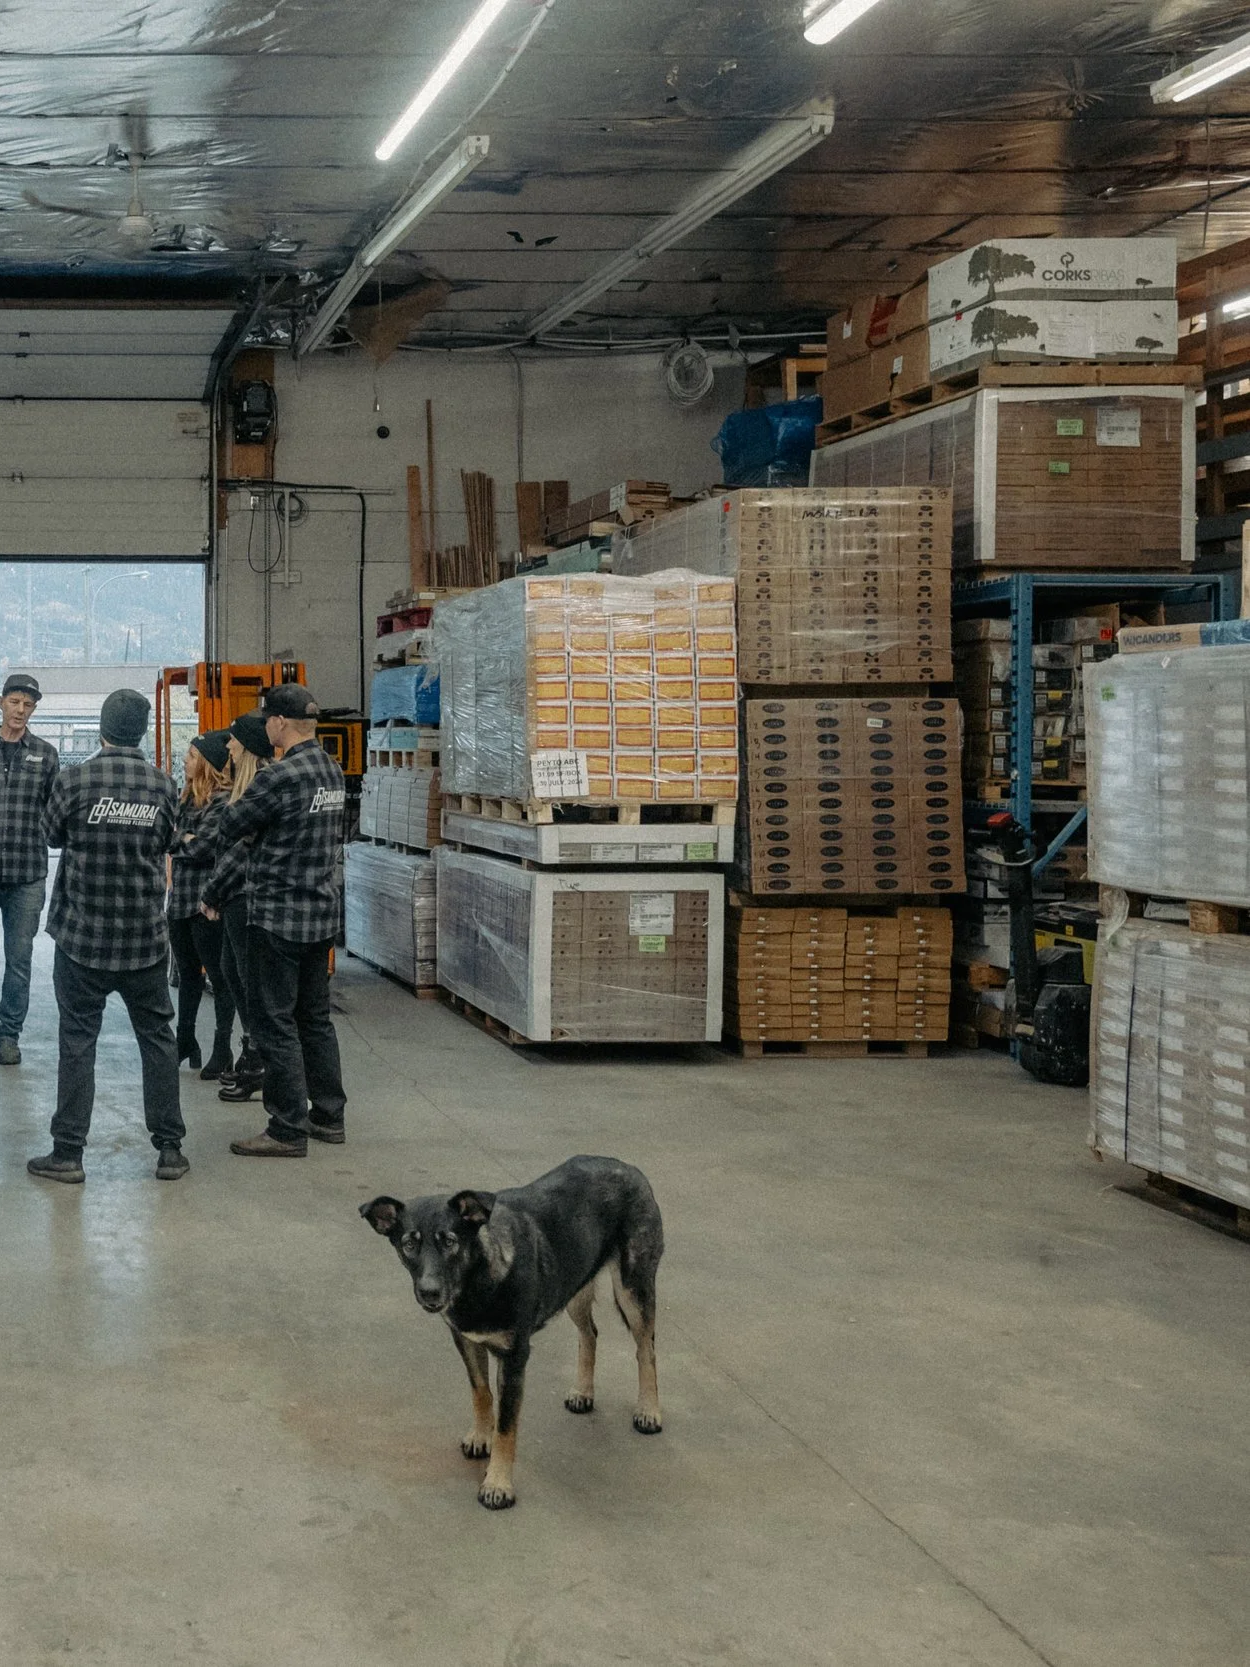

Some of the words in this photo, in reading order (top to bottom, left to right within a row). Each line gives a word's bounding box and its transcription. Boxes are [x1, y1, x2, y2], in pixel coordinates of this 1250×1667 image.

[1123, 632, 1182, 646] WICANDERS
[537, 759, 562, 767] PEYTO
[109, 802, 160, 819] SAMURAI
